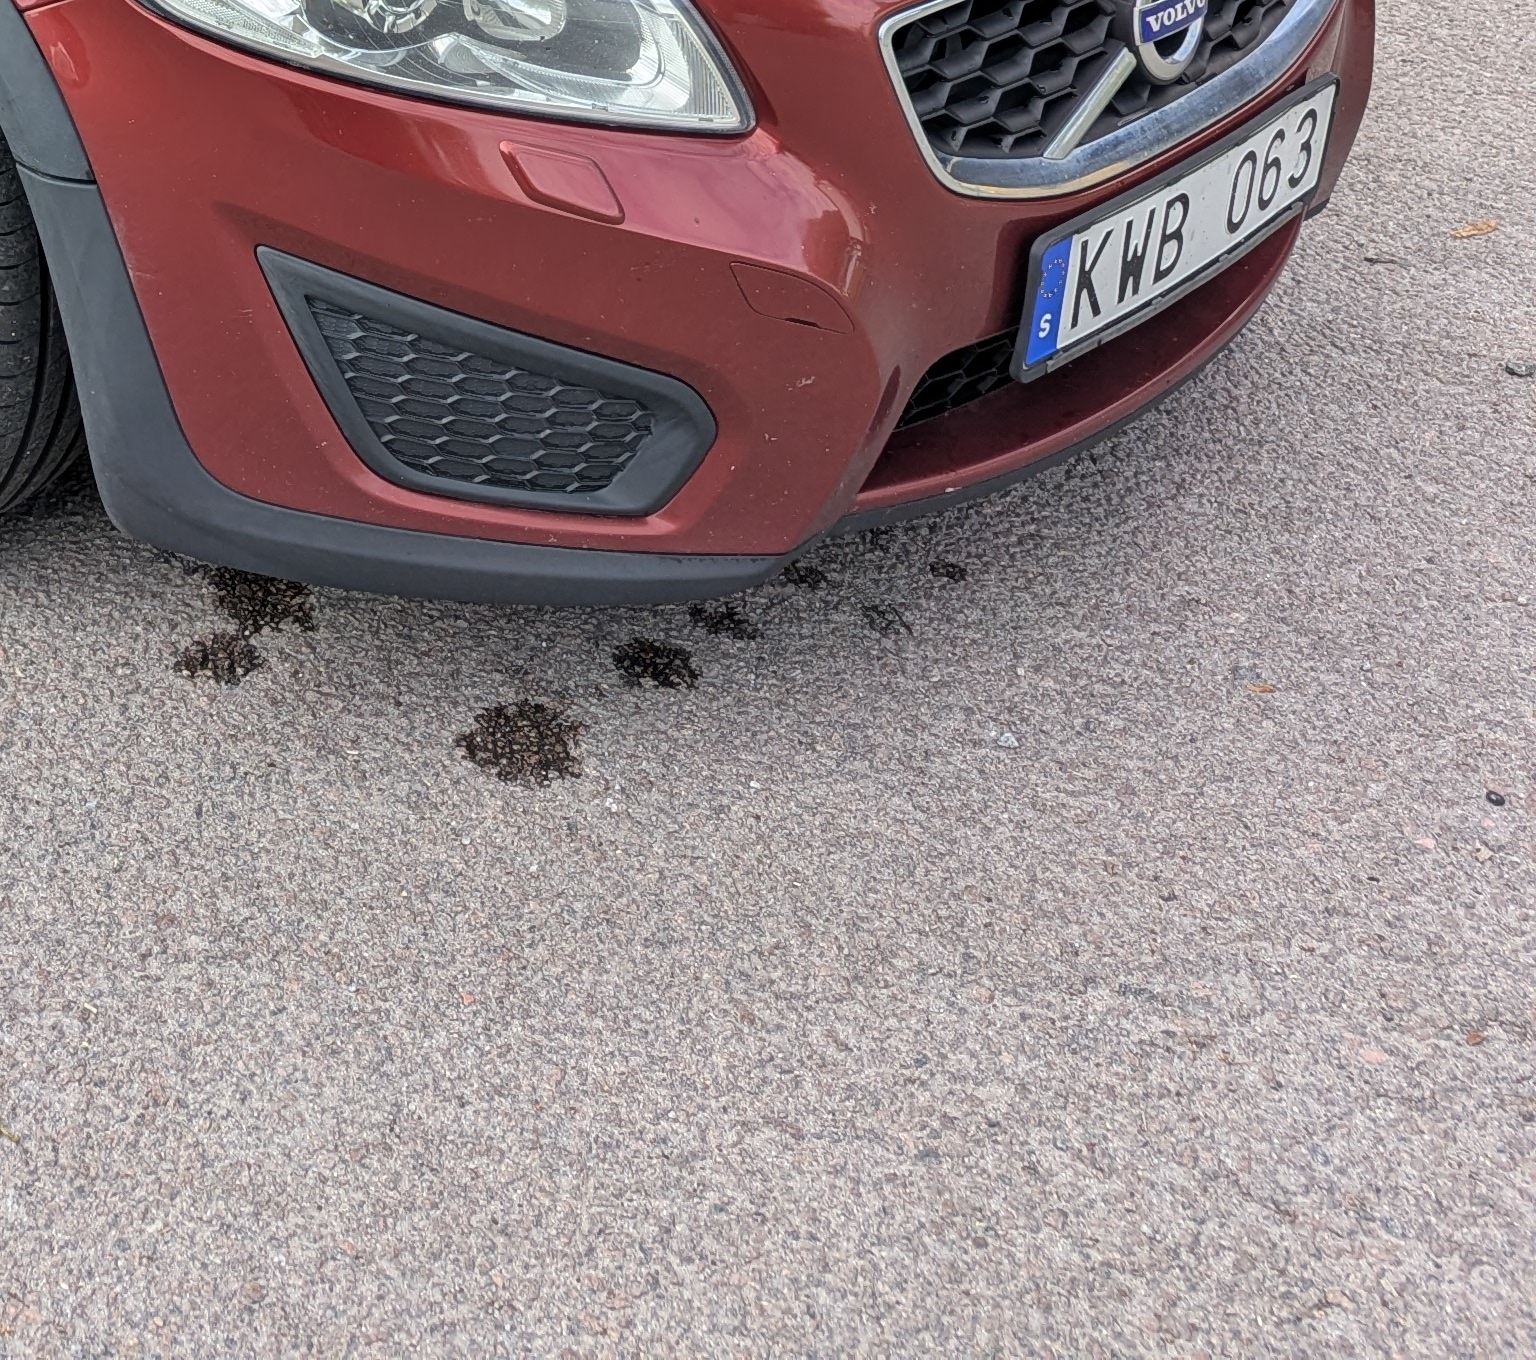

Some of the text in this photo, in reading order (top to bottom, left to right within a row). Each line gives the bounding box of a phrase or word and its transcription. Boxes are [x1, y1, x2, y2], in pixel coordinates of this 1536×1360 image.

[1070, 107, 1319, 330] KWB 063
[1038, 312, 1052, 339] S
